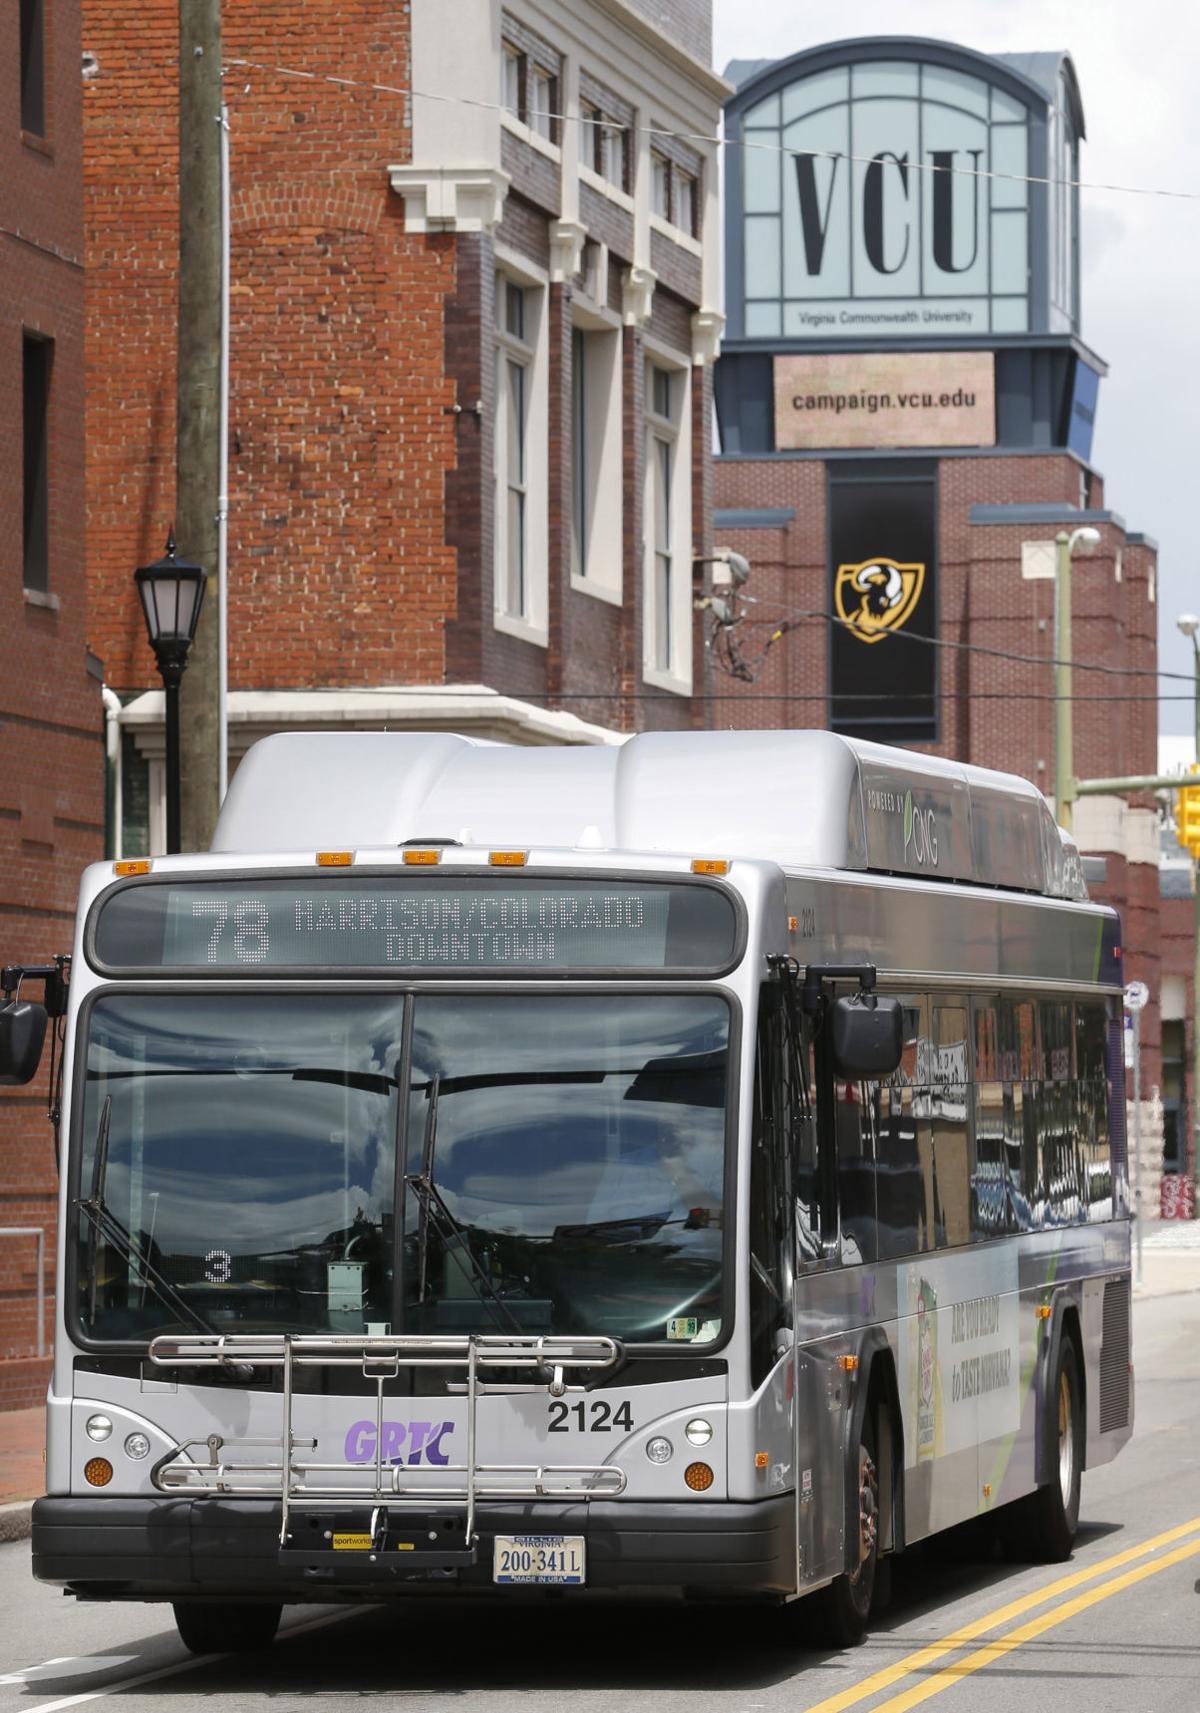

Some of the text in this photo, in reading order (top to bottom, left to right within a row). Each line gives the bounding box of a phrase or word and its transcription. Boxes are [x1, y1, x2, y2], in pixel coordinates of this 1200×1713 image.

[791, 149, 984, 276] VCU
[798, 310, 972, 327] Virginia Commonwealth University
[792, 388, 976, 414] campaign.vcu.edu
[912, 806, 939, 866] CNG
[191, 897, 644, 963] 78 HARRISON/COLORADO
[386, 932, 556, 961] DOWNTOWN
[204, 1250, 231, 1283] 3
[547, 1400, 635, 1433] 2124
[344, 1420, 456, 1466] GRTC
